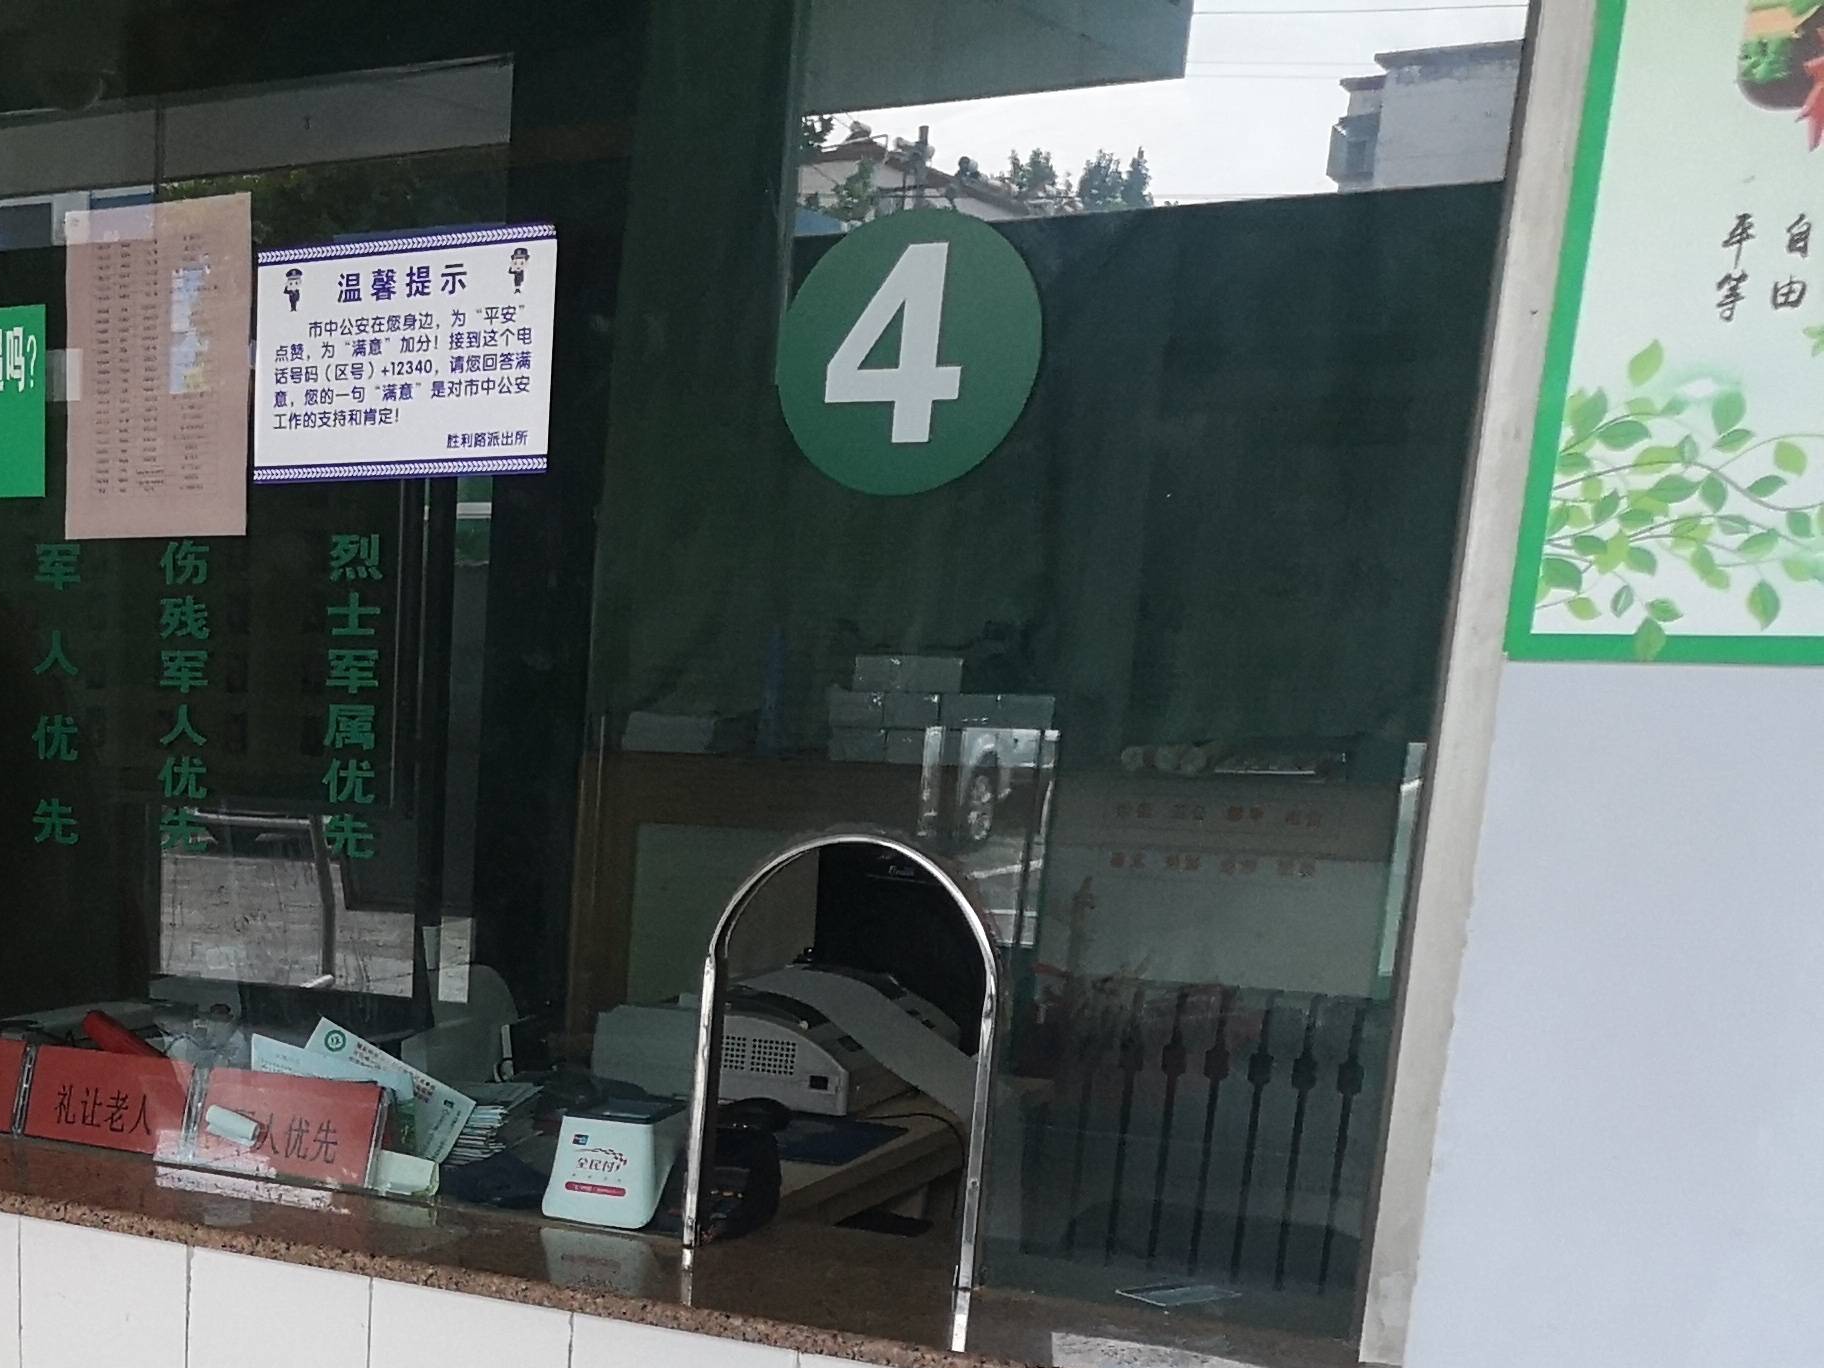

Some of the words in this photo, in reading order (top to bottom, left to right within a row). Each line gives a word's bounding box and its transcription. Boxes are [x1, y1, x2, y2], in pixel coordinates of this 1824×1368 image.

[337, 263, 468, 303] 温馨提示
[1717, 213, 1756, 321] 平等
[1771, 213, 1813, 310] 自由
[825, 242, 961, 443] 4
[446, 430, 528, 449] 胜利路派出所
[32, 543, 81, 846] 军人优先
[159, 540, 210, 853] 伤残军人优先
[322, 534, 382, 859] 烈士军属优先
[54, 1084, 151, 1136] 礼让老人
[234, 1109, 339, 1164] 人优先
